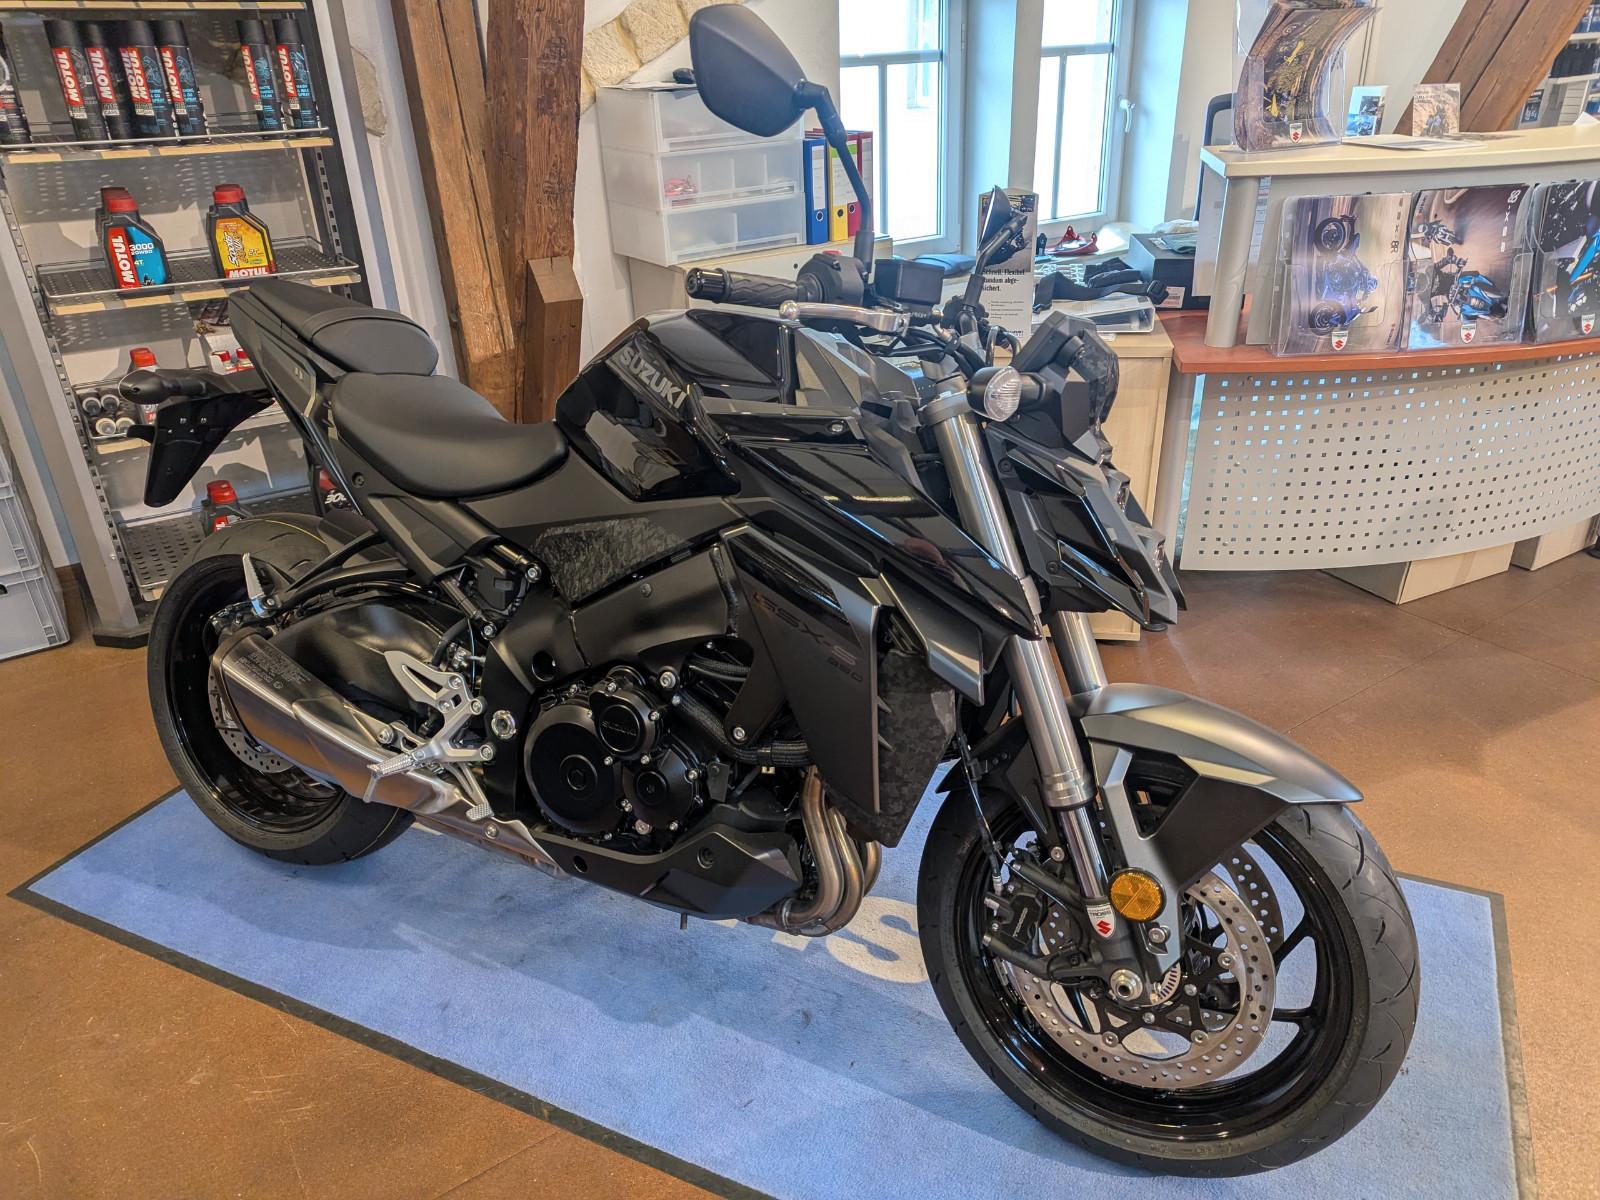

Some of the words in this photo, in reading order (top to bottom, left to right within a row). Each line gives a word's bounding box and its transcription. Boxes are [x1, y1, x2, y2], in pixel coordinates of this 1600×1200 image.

[56, 50, 81, 103] MOTUL
[89, 50, 113, 100] MOTUL
[121, 50, 141, 100] MOTUL
[129, 50, 149, 100] MOTUL
[162, 50, 181, 99] MOTUL
[241, 48, 259, 96] MOTUL
[278, 48, 295, 95] MOTUL
[111, 235, 136, 283] MOTUL
[129, 242, 155, 251] 3000
[229, 266, 268, 278] MOTUL
[619, 346, 688, 409] SUZUKI
[752, 591, 858, 667] GSX-S
